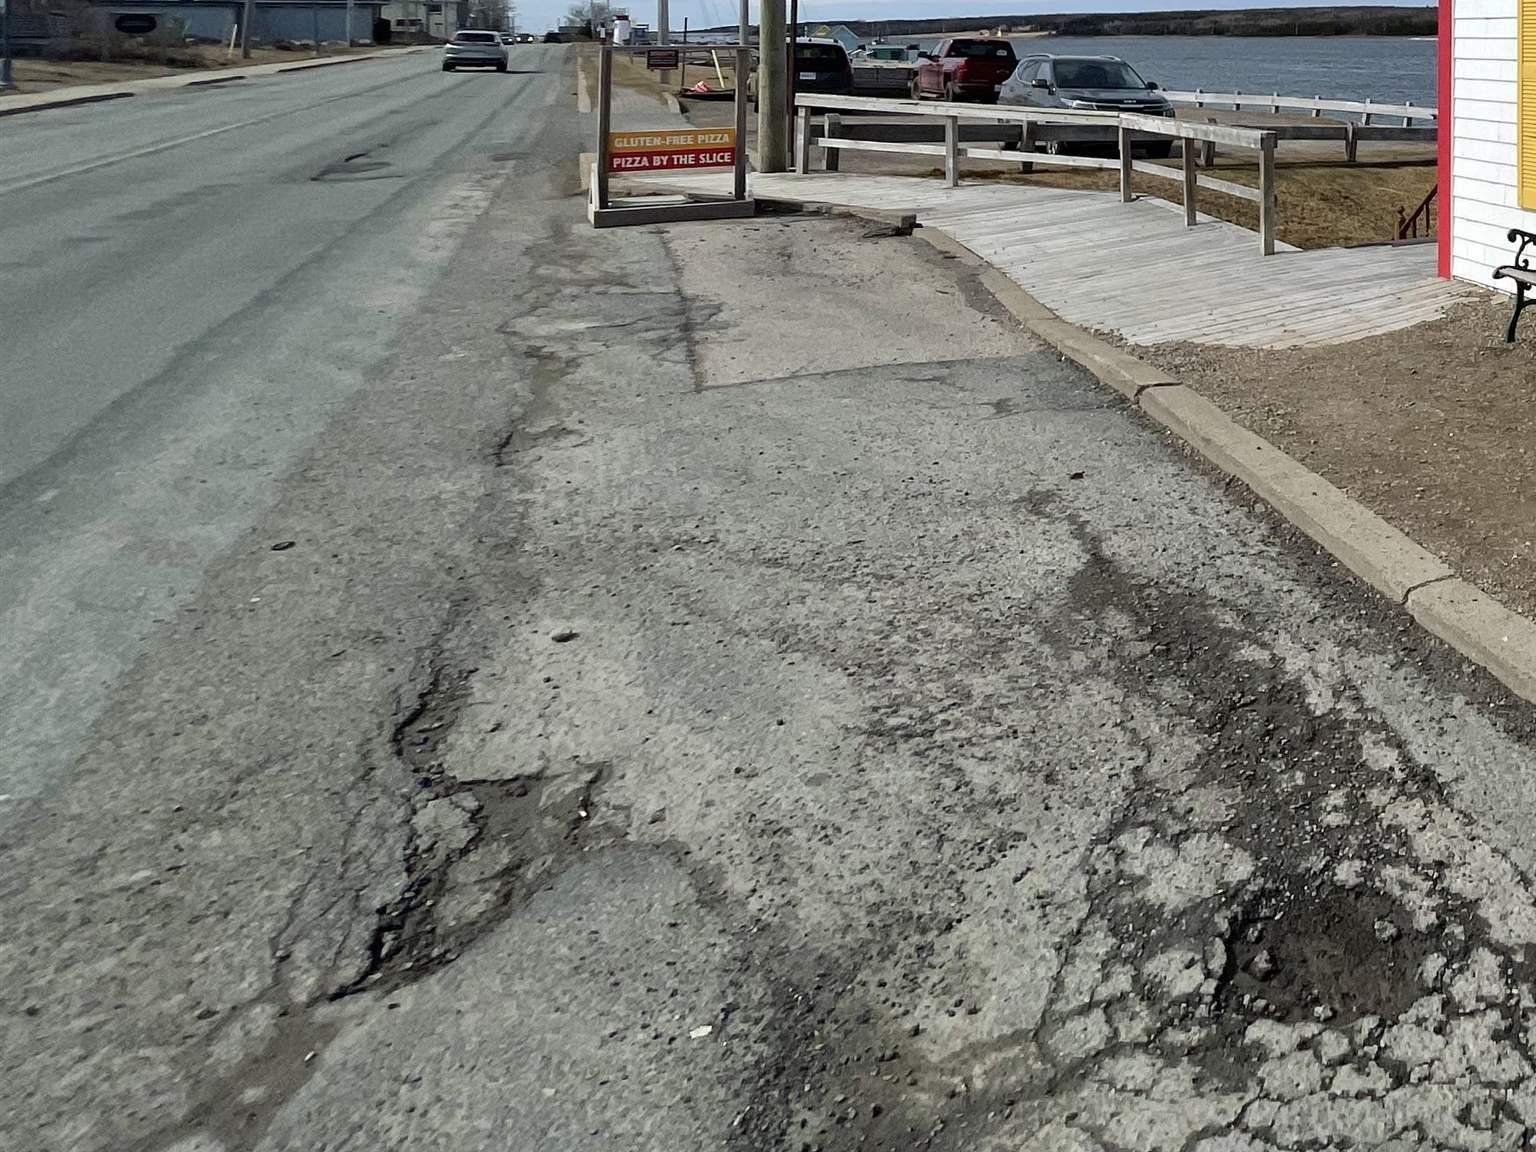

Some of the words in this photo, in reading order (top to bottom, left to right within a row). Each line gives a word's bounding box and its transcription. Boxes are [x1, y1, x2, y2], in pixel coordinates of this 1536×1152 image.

[614, 134, 695, 148] GLUTEN-FREE
[697, 133, 730, 145] PIZZA
[612, 156, 649, 168] PIZZA
[652, 155, 669, 166] BY
[672, 153, 696, 165] THE
[699, 152, 732, 164] SLICE
